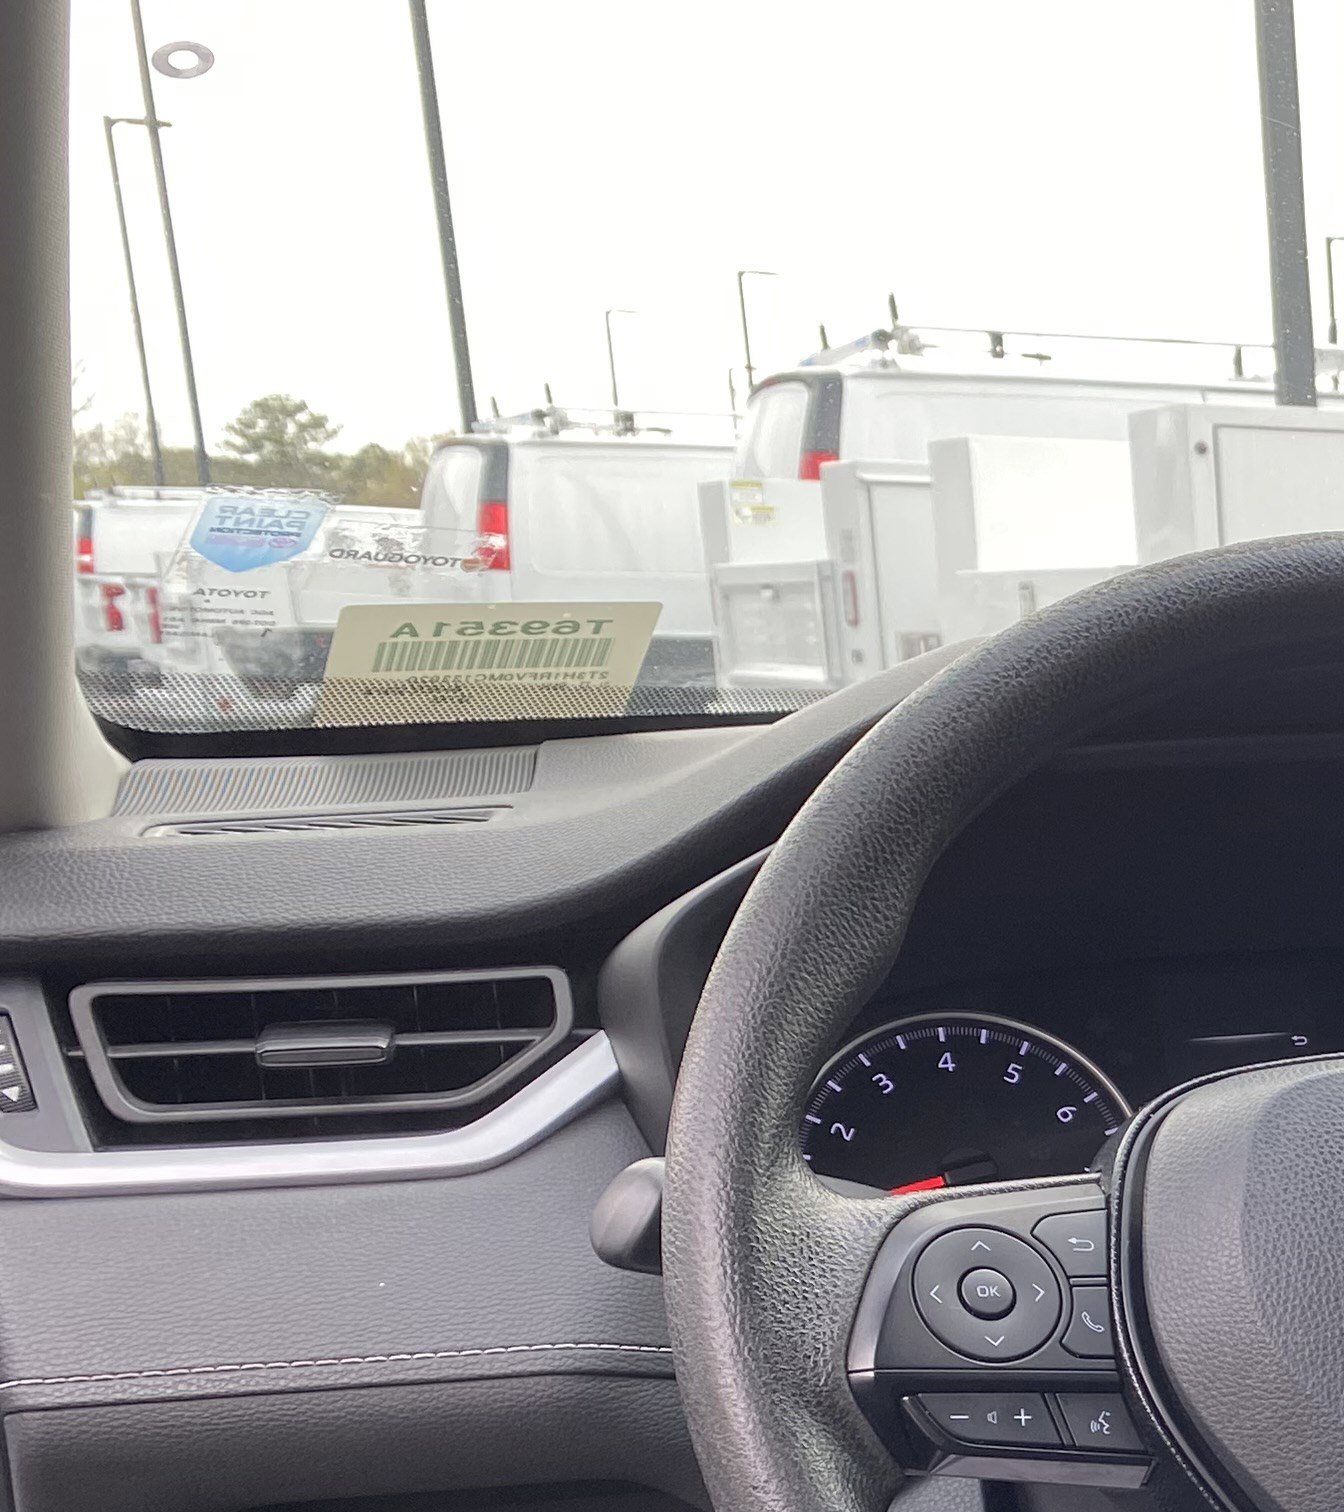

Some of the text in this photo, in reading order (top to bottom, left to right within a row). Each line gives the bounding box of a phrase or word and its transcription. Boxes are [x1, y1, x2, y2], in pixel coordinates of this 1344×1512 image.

[938, 1052, 956, 1072] 4
[1003, 1063, 1023, 1084] 5
[871, 1073, 894, 1095] 3
[1056, 1106, 1077, 1123] 6
[830, 1122, 855, 1142] 2
[976, 1285, 1001, 1298] OK
